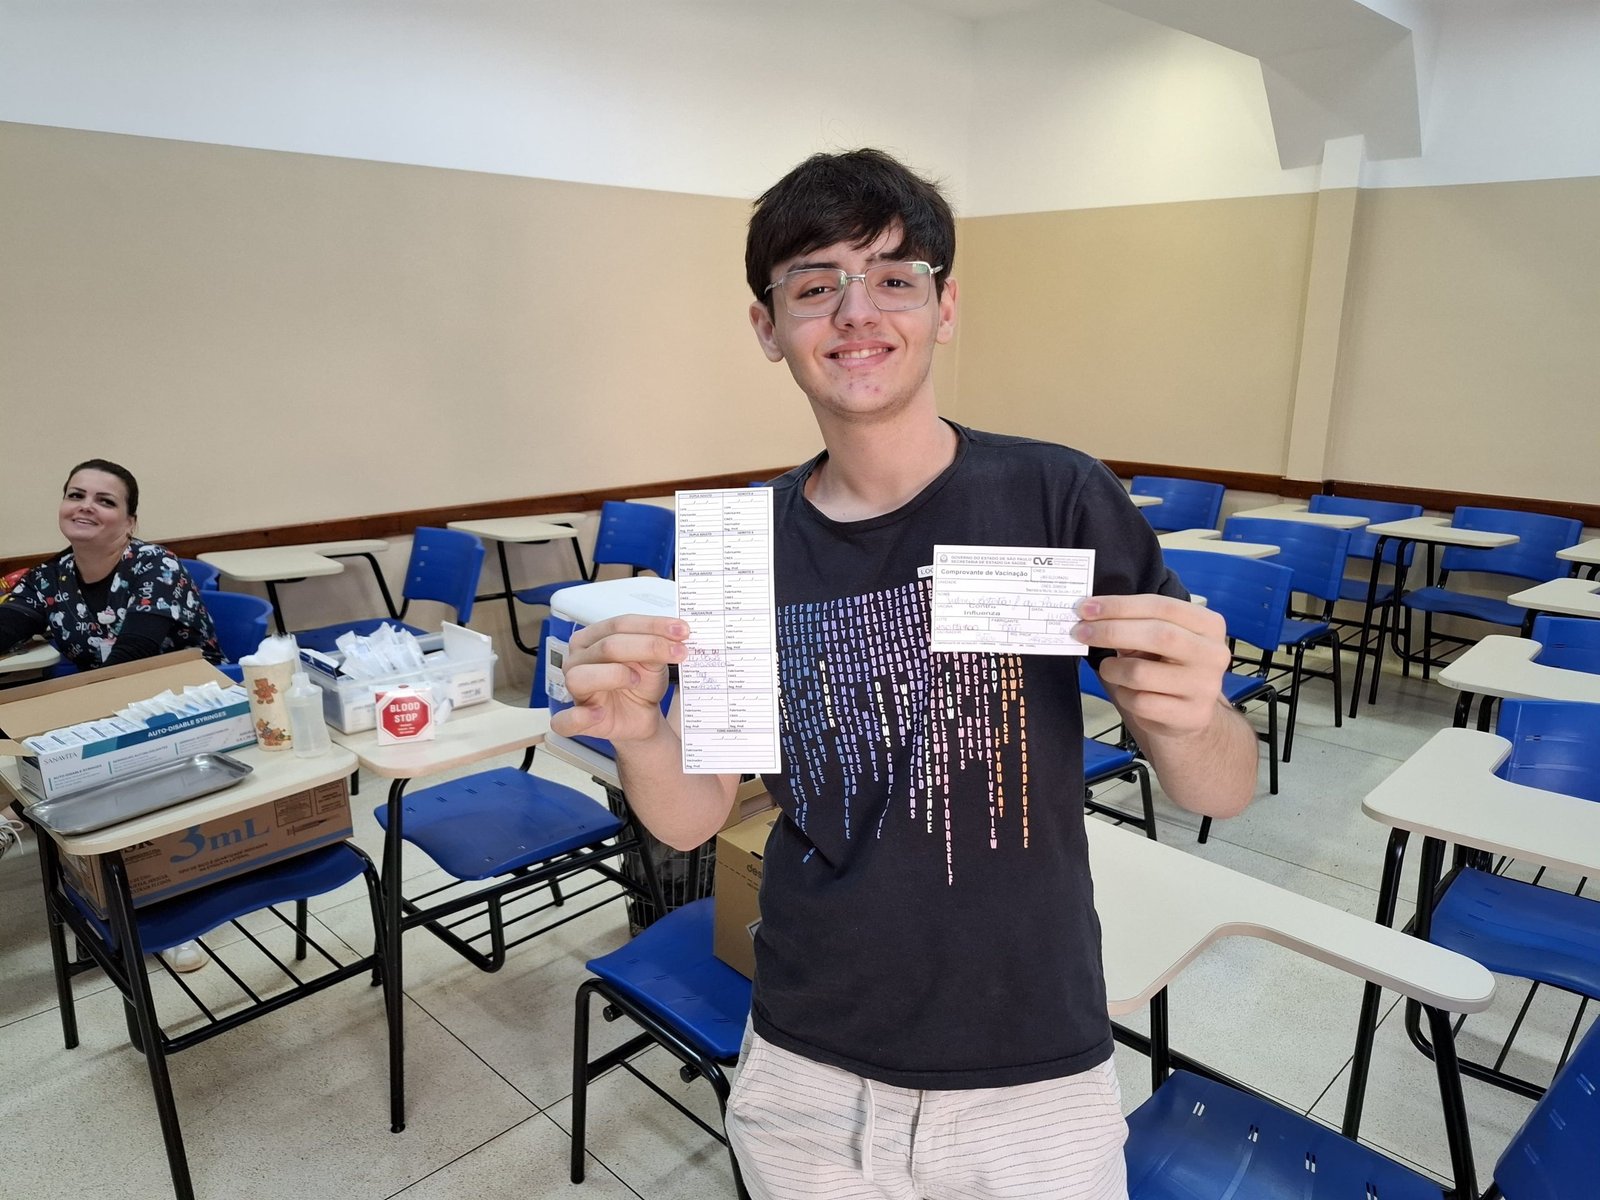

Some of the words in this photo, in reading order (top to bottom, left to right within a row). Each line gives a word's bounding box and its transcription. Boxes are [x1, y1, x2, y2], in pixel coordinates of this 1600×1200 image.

[940, 568, 984, 576] Comprovante
[994, 569, 1028, 578] Vacinação
[1033, 557, 1054, 566] CVE
[389, 701, 420, 713] BLOOD
[819, 660, 836, 728] HIGHER
[874, 681, 891, 748] DREAMS
[900, 683, 912, 730] WALK
[945, 671, 955, 720] FLOW
[147, 718, 196, 738] AUTO-DISABLE
[195, 710, 227, 725] SYRINGES
[394, 712, 418, 724] STOP
[43, 752, 78, 766] SANAVITA
[923, 714, 933, 834] DIFFERENCE
[170, 818, 273, 864] 3mL
[944, 798, 953, 886] YOURSELF
[989, 806, 998, 849] VIEW
